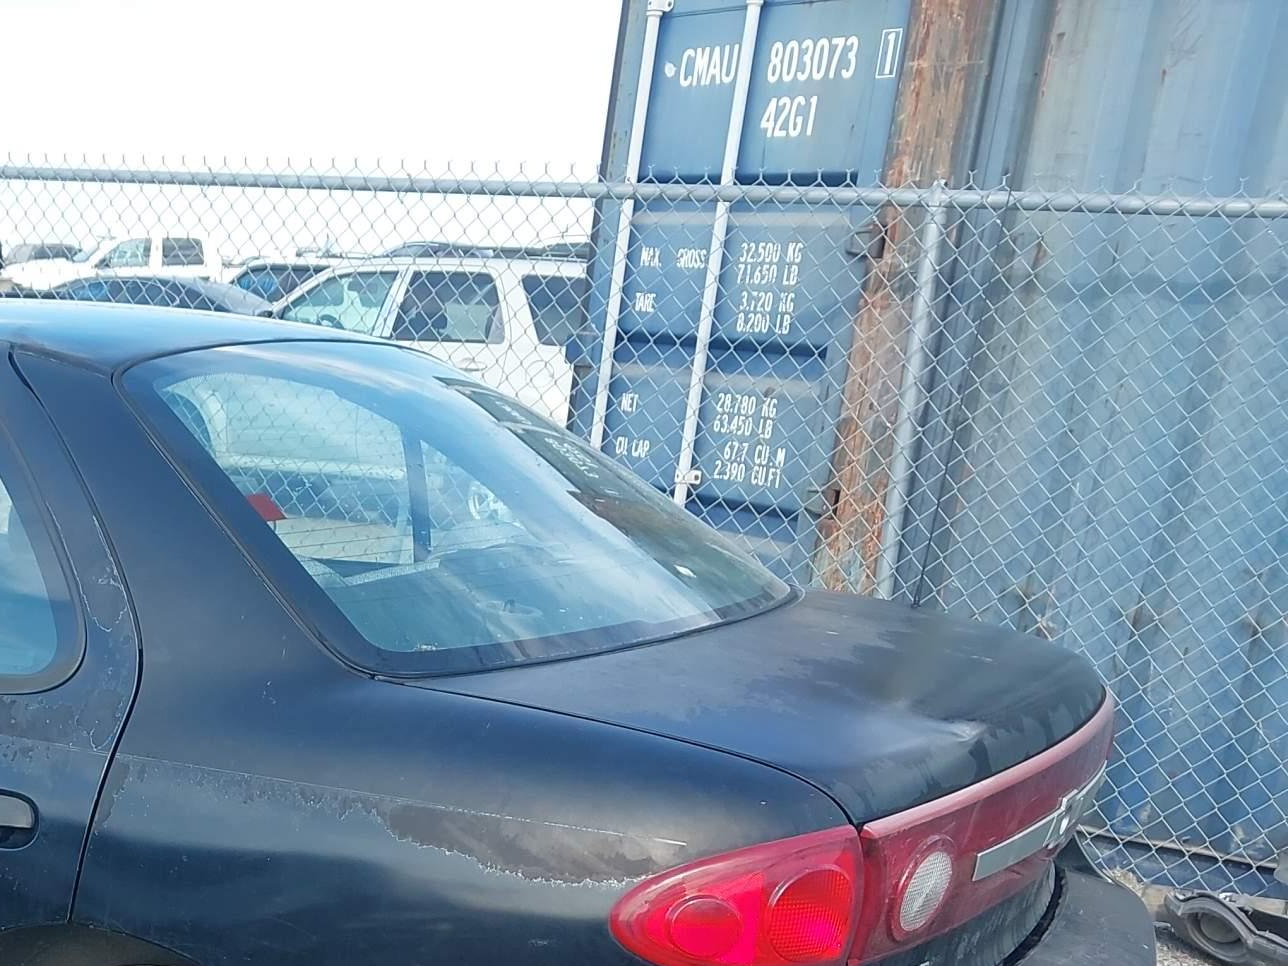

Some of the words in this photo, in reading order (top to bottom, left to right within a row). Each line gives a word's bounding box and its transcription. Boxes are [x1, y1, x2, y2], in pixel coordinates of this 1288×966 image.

[679, 43, 740, 87] CMAU
[767, 36, 859, 84] 803073
[760, 95, 819, 138] 42G1
[677, 248, 707, 269] GROSS
[739, 242, 781, 263] 32.500
[787, 242, 804, 263] KG
[737, 263, 777, 285] 71.650
[783, 264, 799, 285] LB
[635, 292, 656, 313] TARE
[739, 291, 773, 312] 3.720
[778, 292, 795, 313] KG
[736, 312, 770, 334] 8.200
[776, 314, 791, 335] LB
[621, 393, 639, 413] NET
[717, 393, 756, 415] 28.780
[761, 398, 778, 418] KG
[713, 414, 752, 436] 63.450
[758, 418, 773, 439] LB
[724, 441, 749, 462] 67.7
[713, 460, 746, 482] 2.390
